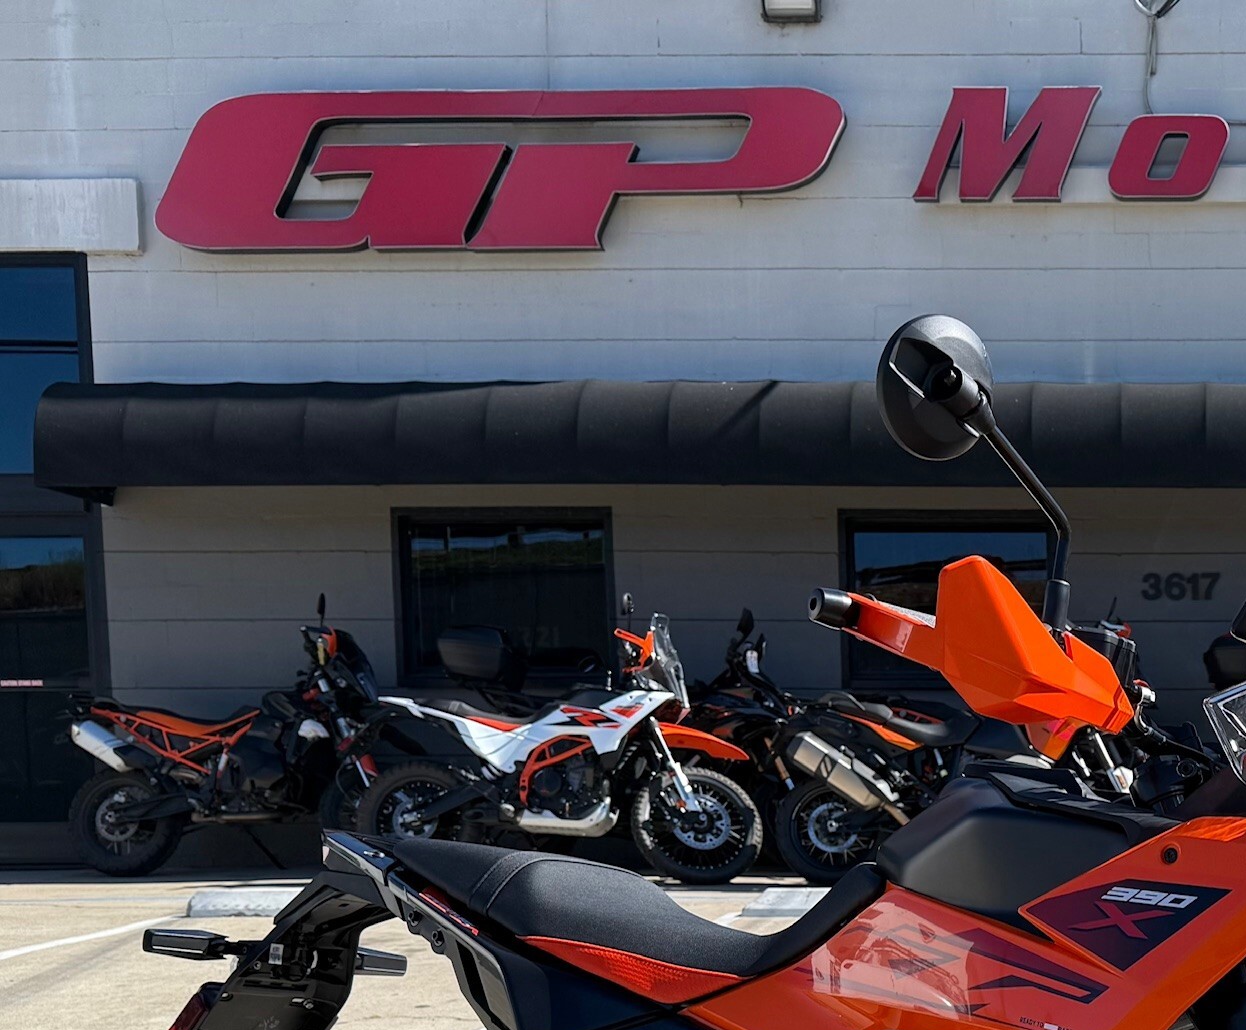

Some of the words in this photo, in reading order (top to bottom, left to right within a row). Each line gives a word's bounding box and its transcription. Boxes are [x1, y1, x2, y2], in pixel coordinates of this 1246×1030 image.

[154, 86, 848, 253] GP
[1141, 572, 1220, 601] 3617
[1100, 886, 1198, 909] 390
[1067, 900, 1176, 940] X
[1019, 1016, 1036, 1026] READY
[1036, 1021, 1045, 1029] TO
